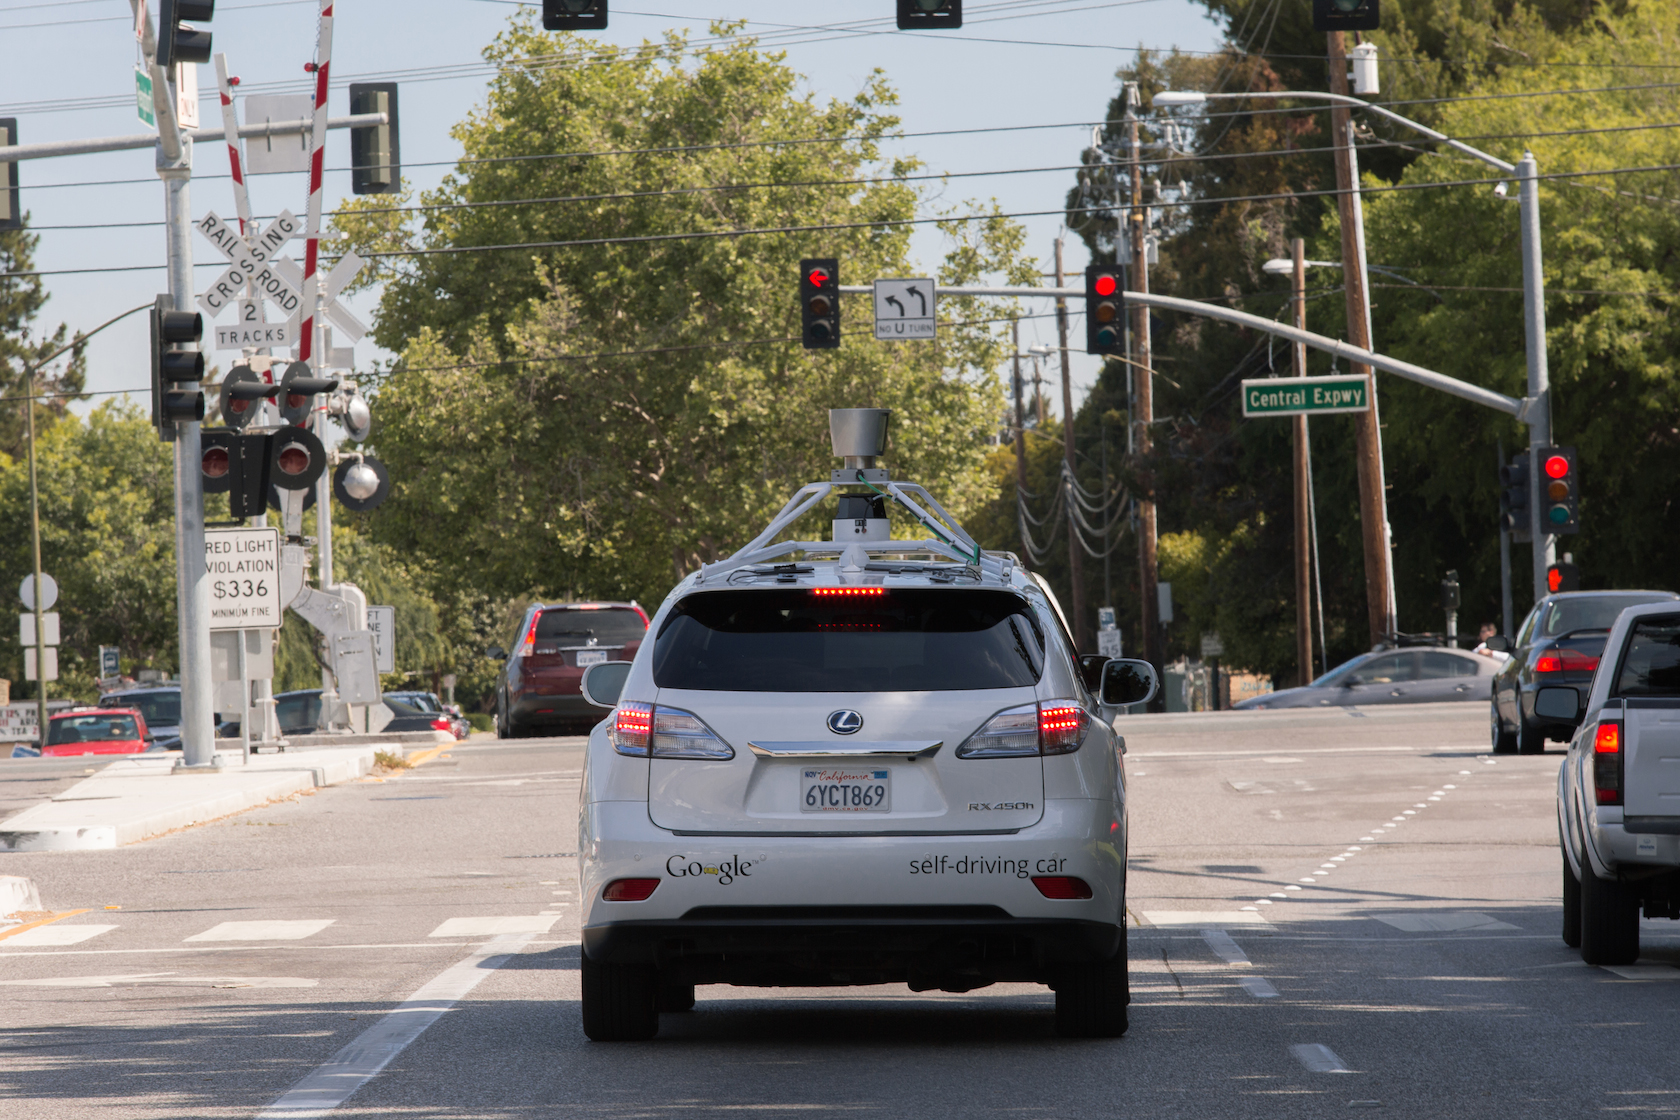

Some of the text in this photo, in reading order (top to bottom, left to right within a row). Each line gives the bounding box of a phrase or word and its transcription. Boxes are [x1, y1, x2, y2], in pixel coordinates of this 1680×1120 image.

[201, 216, 298, 311] RAIL ROAD
[207, 219, 293, 308] CROSSING
[244, 304, 256, 321] 2
[219, 329, 285, 344] TRACKS
[879, 323, 932, 334] NO U TURN
[1250, 387, 1362, 407] Central Expwy
[205, 540, 274, 554] RED LIGHT
[205, 559, 274, 573] VIOLATION
[213, 579, 268, 600] $336
[211, 606, 270, 618] MINIMUM FINE
[1101, 644, 1119, 656] 35
[805, 770, 817, 778] NOV
[819, 770, 874, 784] California
[806, 785, 885, 807] 6YCT869
[666, 854, 752, 885] Gogle
[909, 855, 1067, 879] self-driving car
